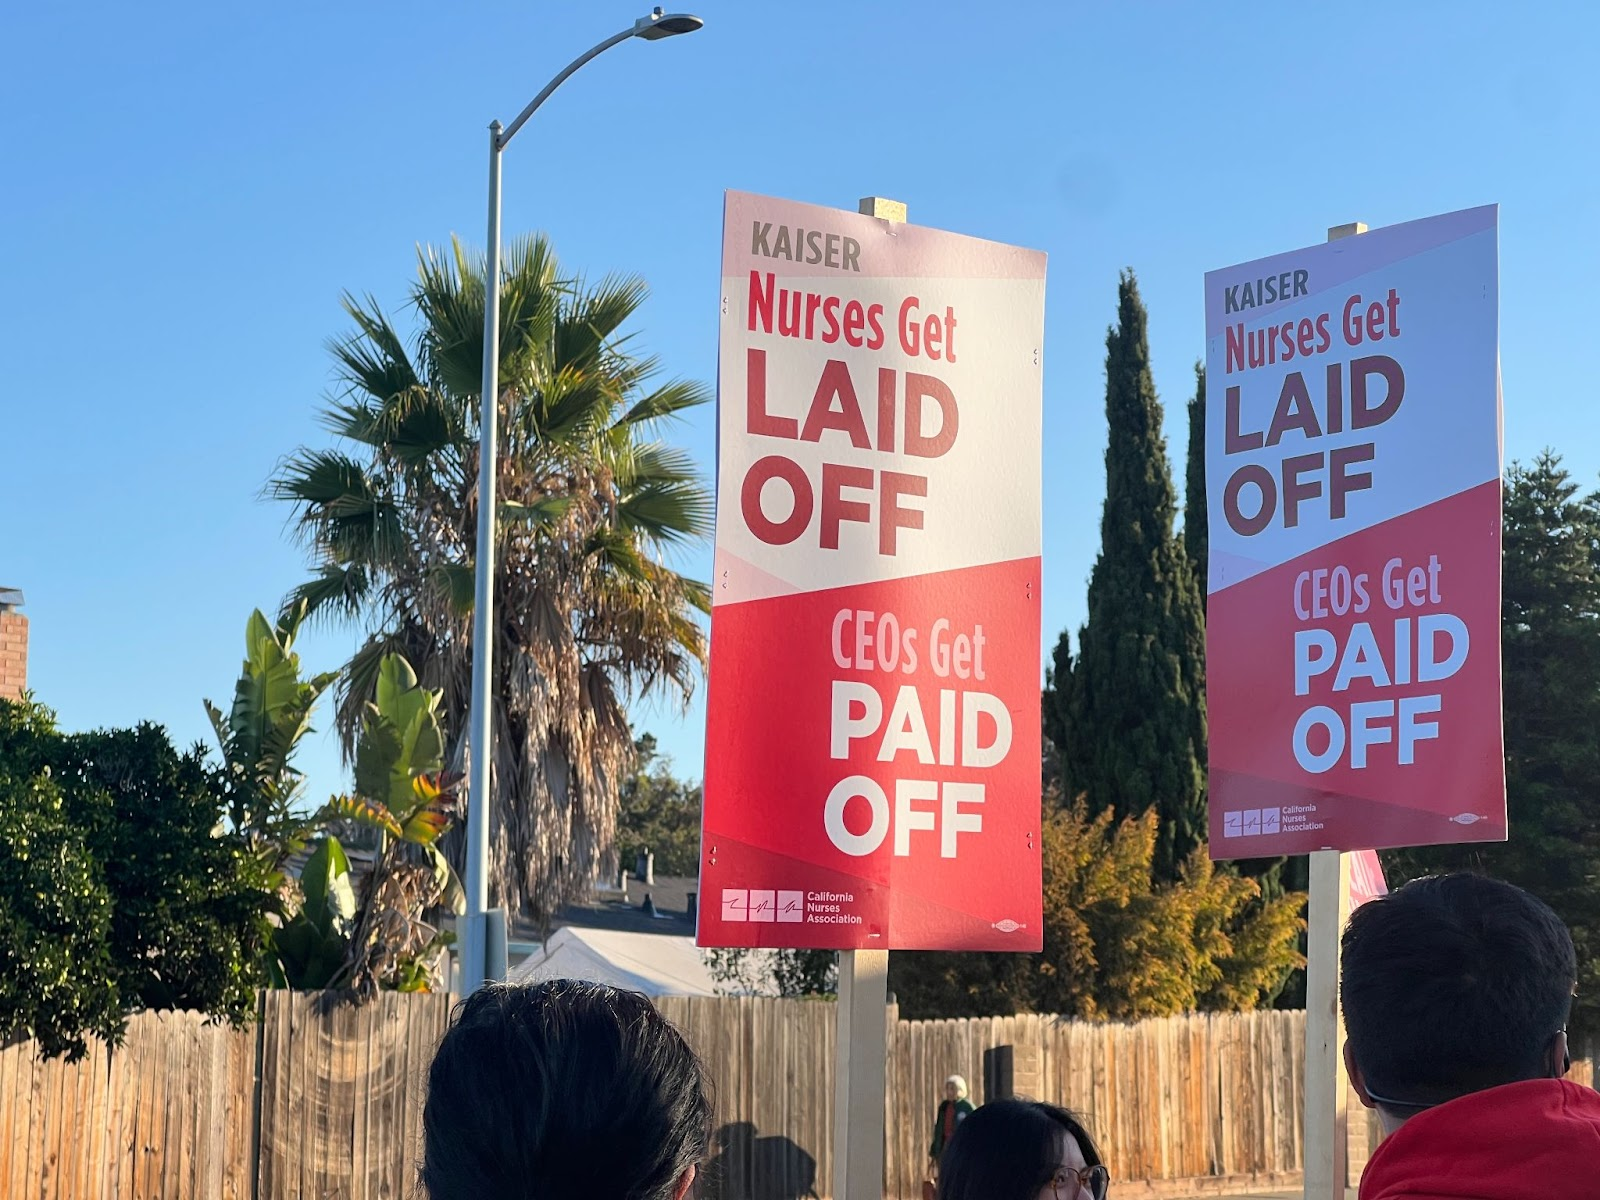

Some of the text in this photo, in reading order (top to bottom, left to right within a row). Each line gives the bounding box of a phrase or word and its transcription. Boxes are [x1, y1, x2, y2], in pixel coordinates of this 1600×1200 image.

[752, 221, 861, 272] KAISER
[747, 270, 957, 363] Nurses Get
[1225, 269, 1309, 315] KAISER
[1225, 288, 1401, 375] Nurses Get
[747, 348, 959, 459] LAID
[1225, 355, 1406, 455] LAID
[741, 455, 928, 556] OFF
[1223, 442, 1375, 537] OFF
[1293, 555, 1442, 621] CEOs Get
[831, 608, 986, 681] CEOs Get
[1294, 613, 1470, 696] PAID
[830, 680, 1013, 768] PAID
[1292, 694, 1442, 774] OFF
[824, 775, 986, 858] OFF
[1282, 803, 1317, 814] California
[1282, 814, 1307, 823] Nurses
[1282, 822, 1324, 832] Association
[807, 891, 854, 902] California
[807, 902, 840, 912] Nurses
[807, 913, 862, 924] Association
